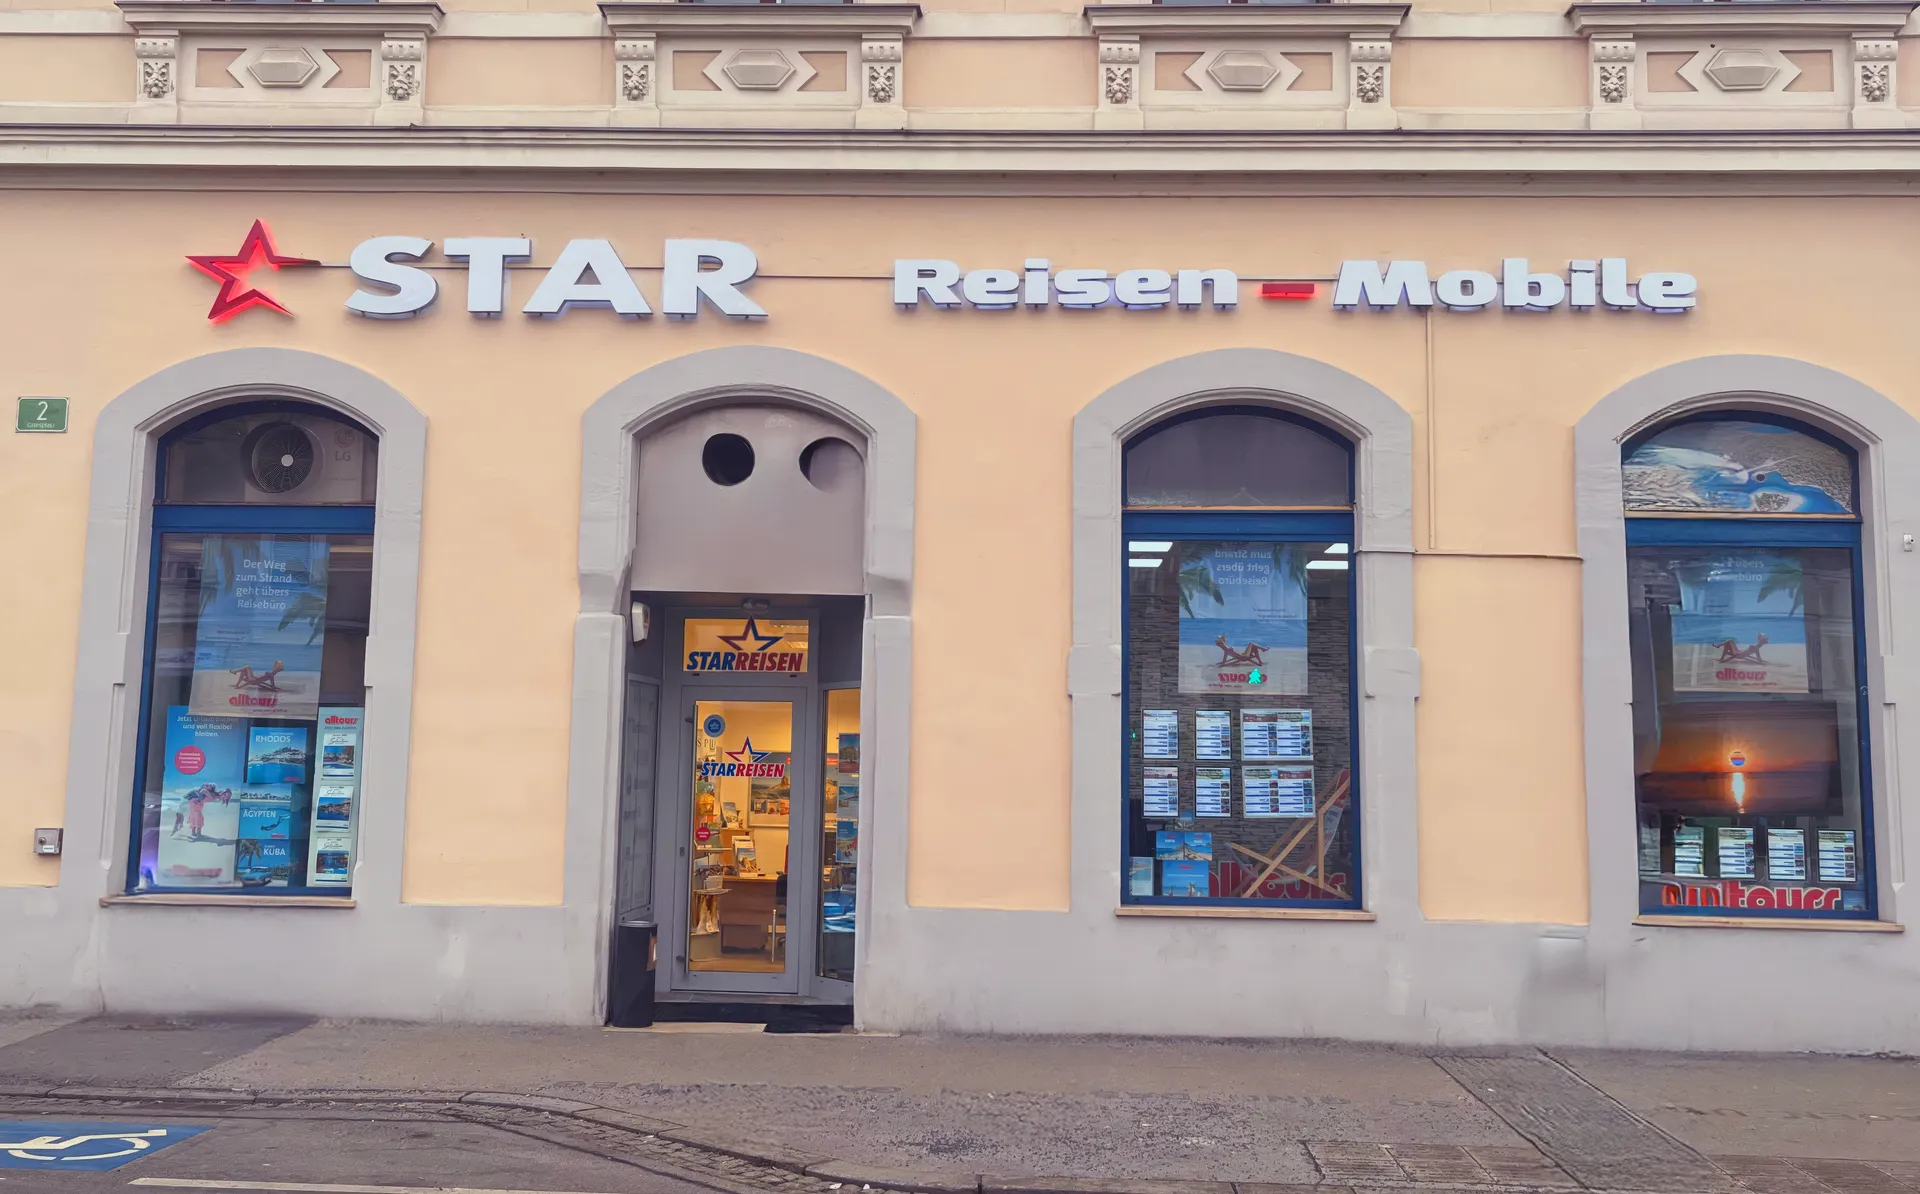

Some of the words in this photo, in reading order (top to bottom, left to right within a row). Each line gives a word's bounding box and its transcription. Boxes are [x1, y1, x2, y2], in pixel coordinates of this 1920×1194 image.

[344, 236, 769, 317] STAR
[894, 258, 1238, 310] Reisen
[1333, 257, 1697, 311] Mobile
[36, 401, 48, 421] 2
[335, 451, 352, 461] LG
[243, 559, 261, 568] Der
[264, 559, 287, 572] Weg
[236, 574, 257, 582] zum
[259, 573, 292, 583] Strand
[236, 586, 259, 597] geht
[262, 585, 290, 596] übers
[237, 599, 287, 610] Reisebüro
[686, 651, 804, 672] STARREISEN
[1715, 667, 1768, 682] alltours
[228, 693, 278, 707] alltours
[325, 715, 359, 725] alltours
[255, 735, 291, 743] RHODOS
[701, 762, 785, 778] STARREISEN
[243, 808, 276, 818] ÄGYPTEN
[263, 848, 286, 856] KUBA
